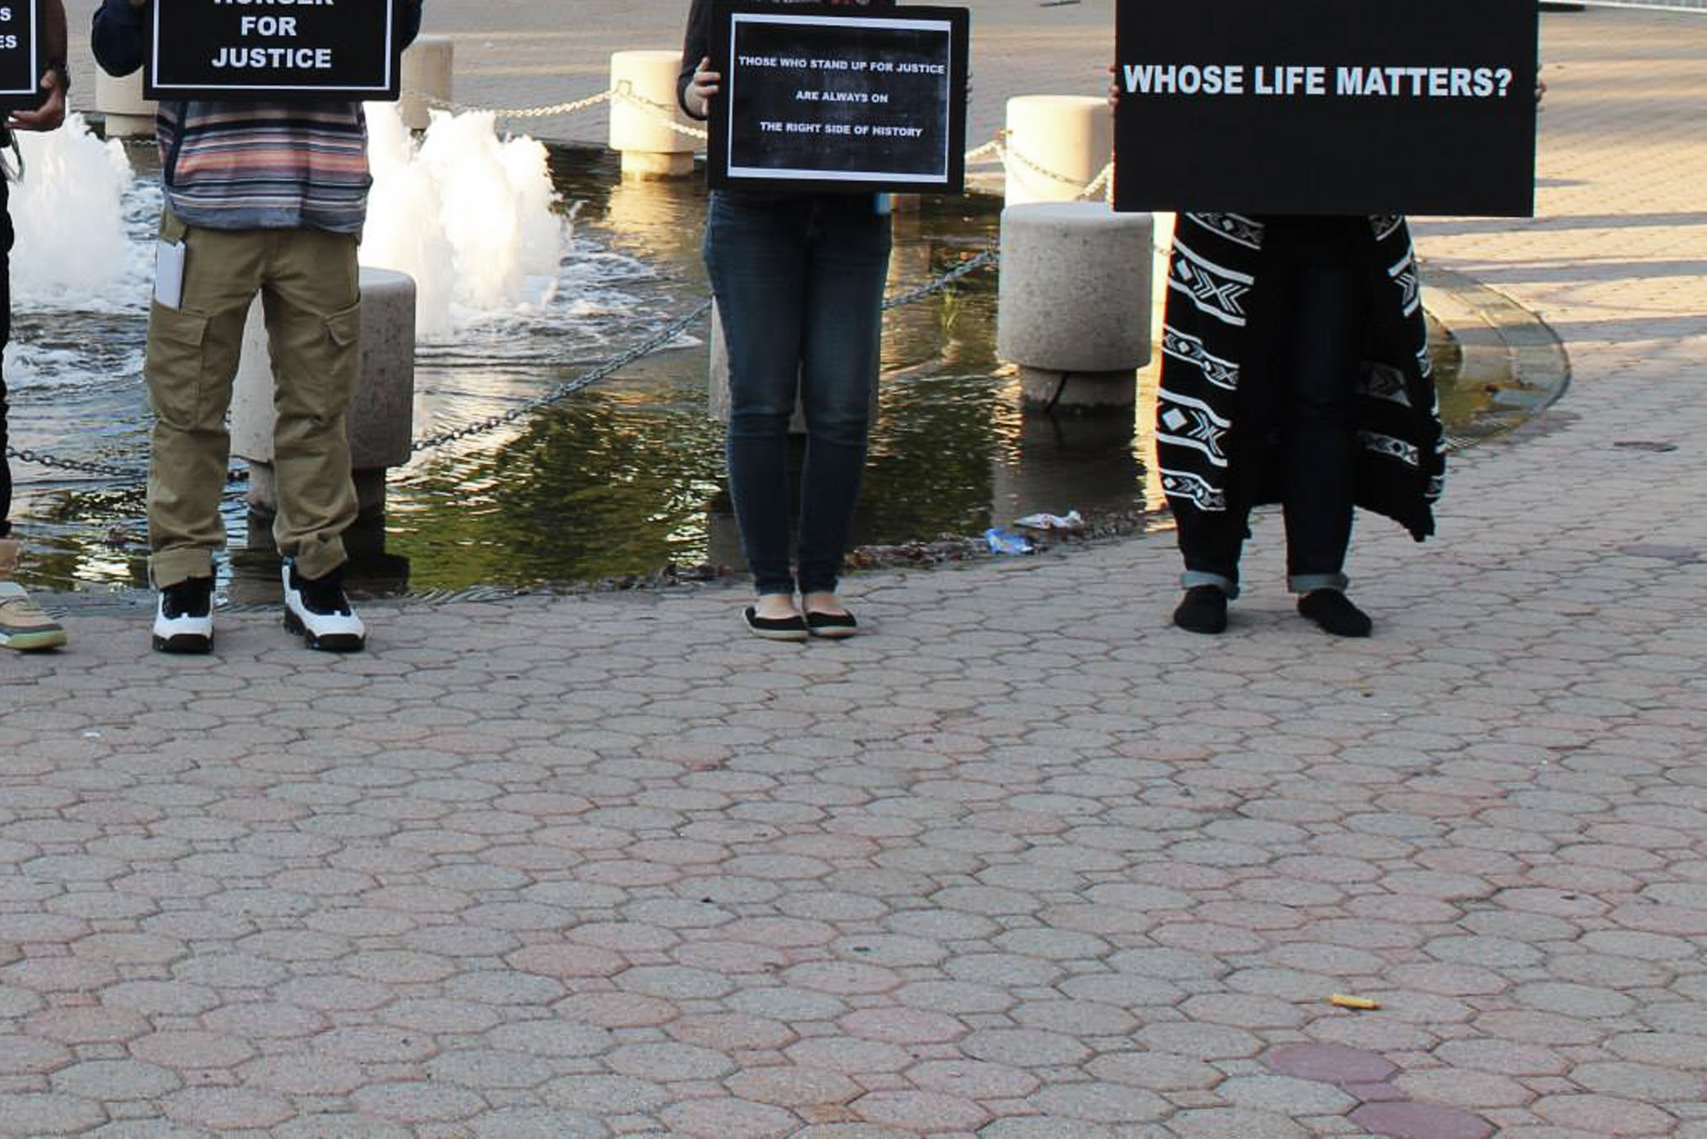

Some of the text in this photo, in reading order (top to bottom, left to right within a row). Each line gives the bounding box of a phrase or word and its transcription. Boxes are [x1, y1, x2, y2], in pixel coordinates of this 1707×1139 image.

[241, 16, 297, 36] FOR
[212, 48, 332, 68] JUSTICE
[738, 56, 945, 75] THOSE WHO STAND UP FOR JUSTICE
[1123, 64, 1513, 97] WHOSE LIFE MATTERS?
[795, 90, 889, 103] ARE ALWAYS ON
[760, 121, 923, 138] THE RIGHT SIDE OF HISTORY
